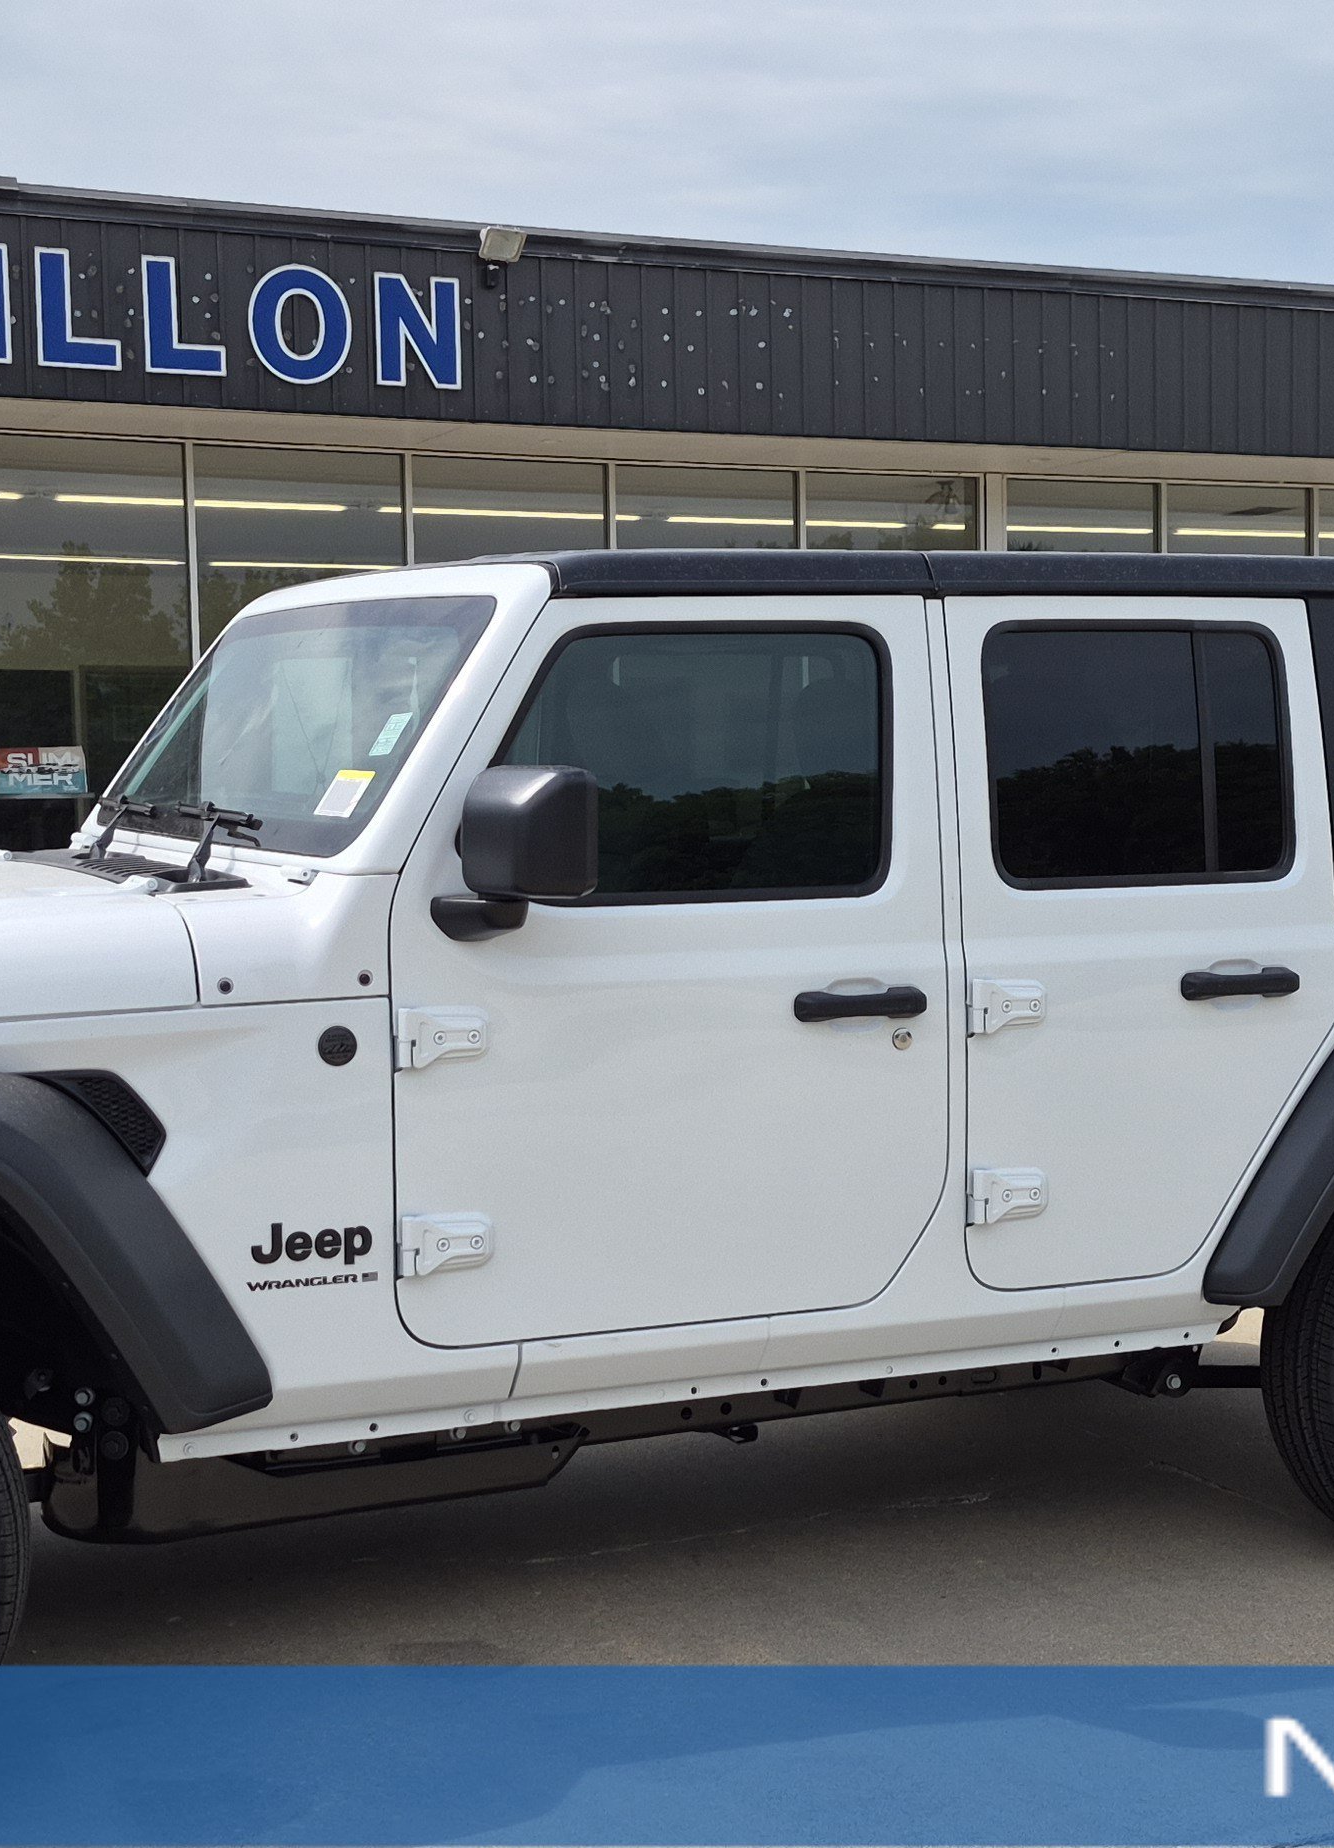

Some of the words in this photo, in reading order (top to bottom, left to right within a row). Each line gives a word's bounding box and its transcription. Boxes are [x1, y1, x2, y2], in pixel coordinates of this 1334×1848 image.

[8, 772, 74, 786] MER
[250, 1222, 373, 1265] Jeep
[246, 1272, 359, 1292] WRANGLER
